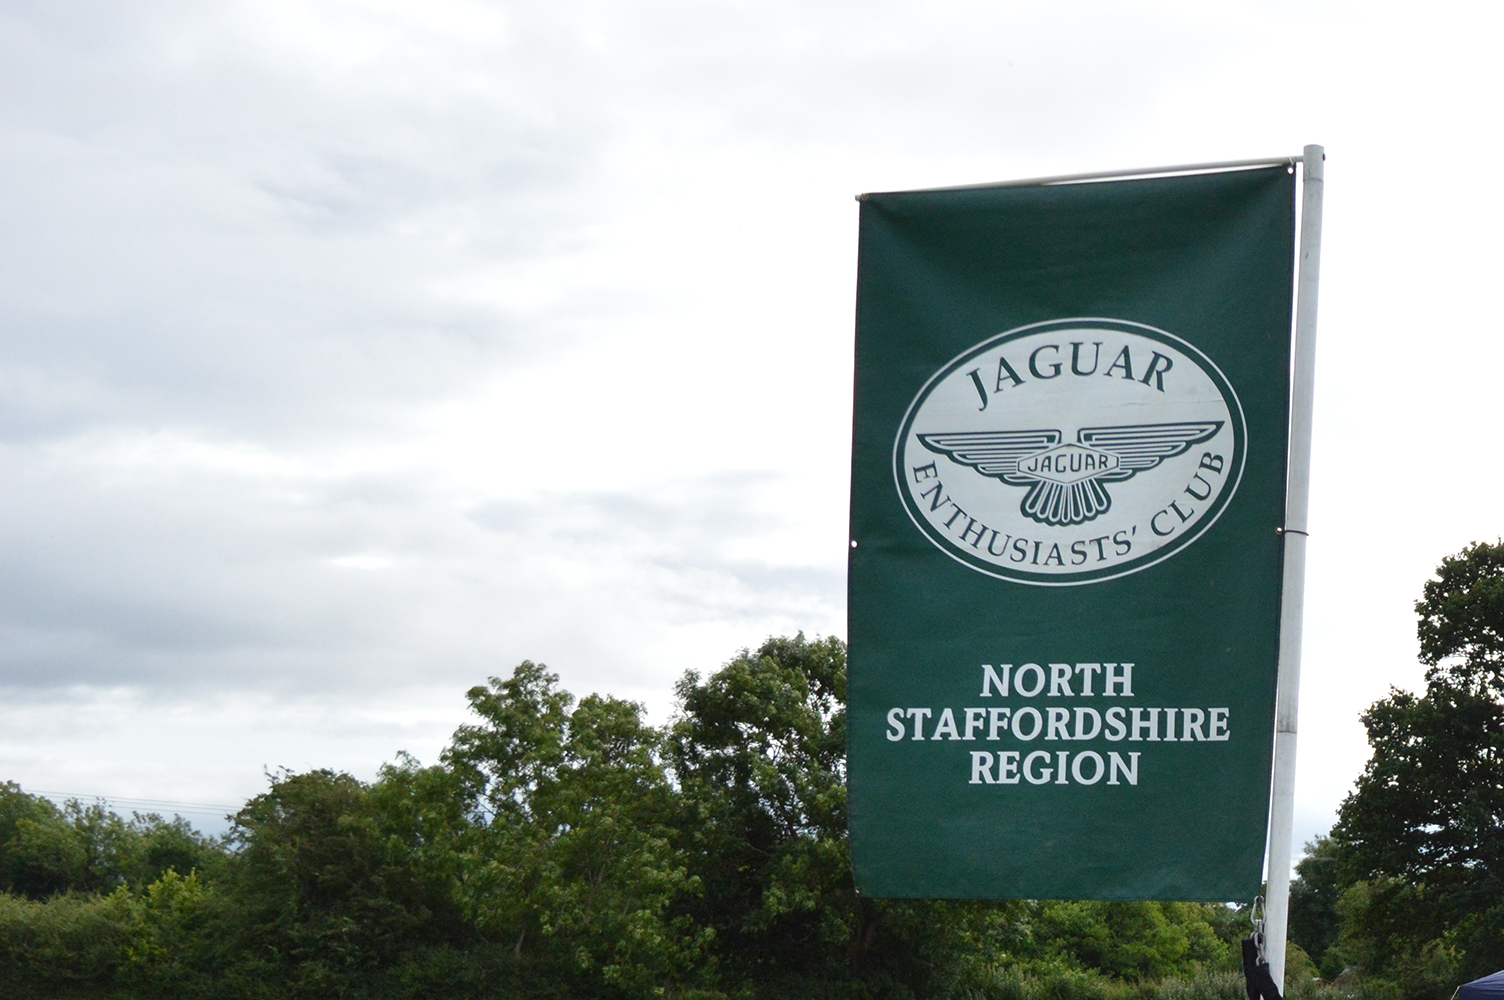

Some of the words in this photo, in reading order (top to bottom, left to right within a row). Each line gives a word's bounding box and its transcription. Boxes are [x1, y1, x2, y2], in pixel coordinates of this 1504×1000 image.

[966, 341, 1174, 412] JAGUAR
[1027, 453, 1109, 473] JAGUAR
[913, 460, 1137, 566] ENTHUSIASTS'
[1150, 451, 1224, 537] CLUB
[980, 663, 1135, 698] NORTH
[886, 706, 1230, 743] STAFFORDSHIRE
[969, 751, 1141, 785] REGION
